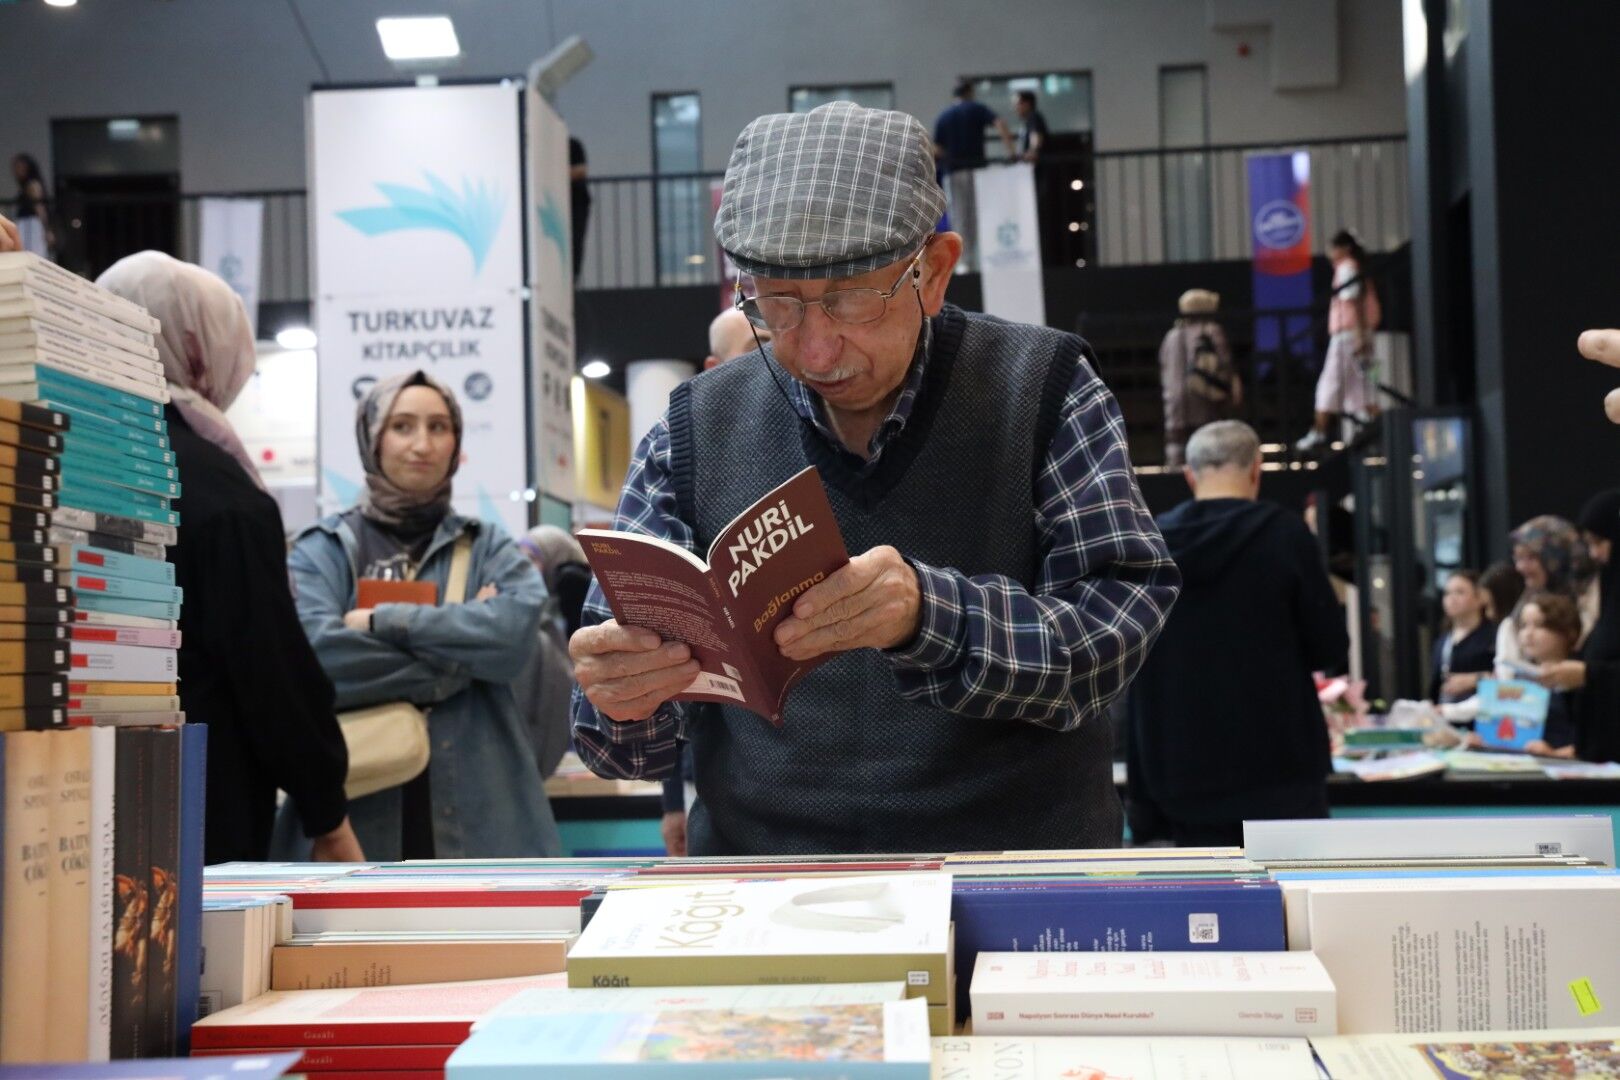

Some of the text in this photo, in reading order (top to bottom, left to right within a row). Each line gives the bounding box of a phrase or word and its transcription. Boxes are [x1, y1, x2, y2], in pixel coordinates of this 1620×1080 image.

[347, 306, 494, 333] TURKUVAZ
[362, 337, 481, 363] KİTAPÇILIK
[753, 571, 825, 633] Bağlanma
[656, 890, 745, 950] Kâğıt
[592, 975, 630, 988] Kâğıt
